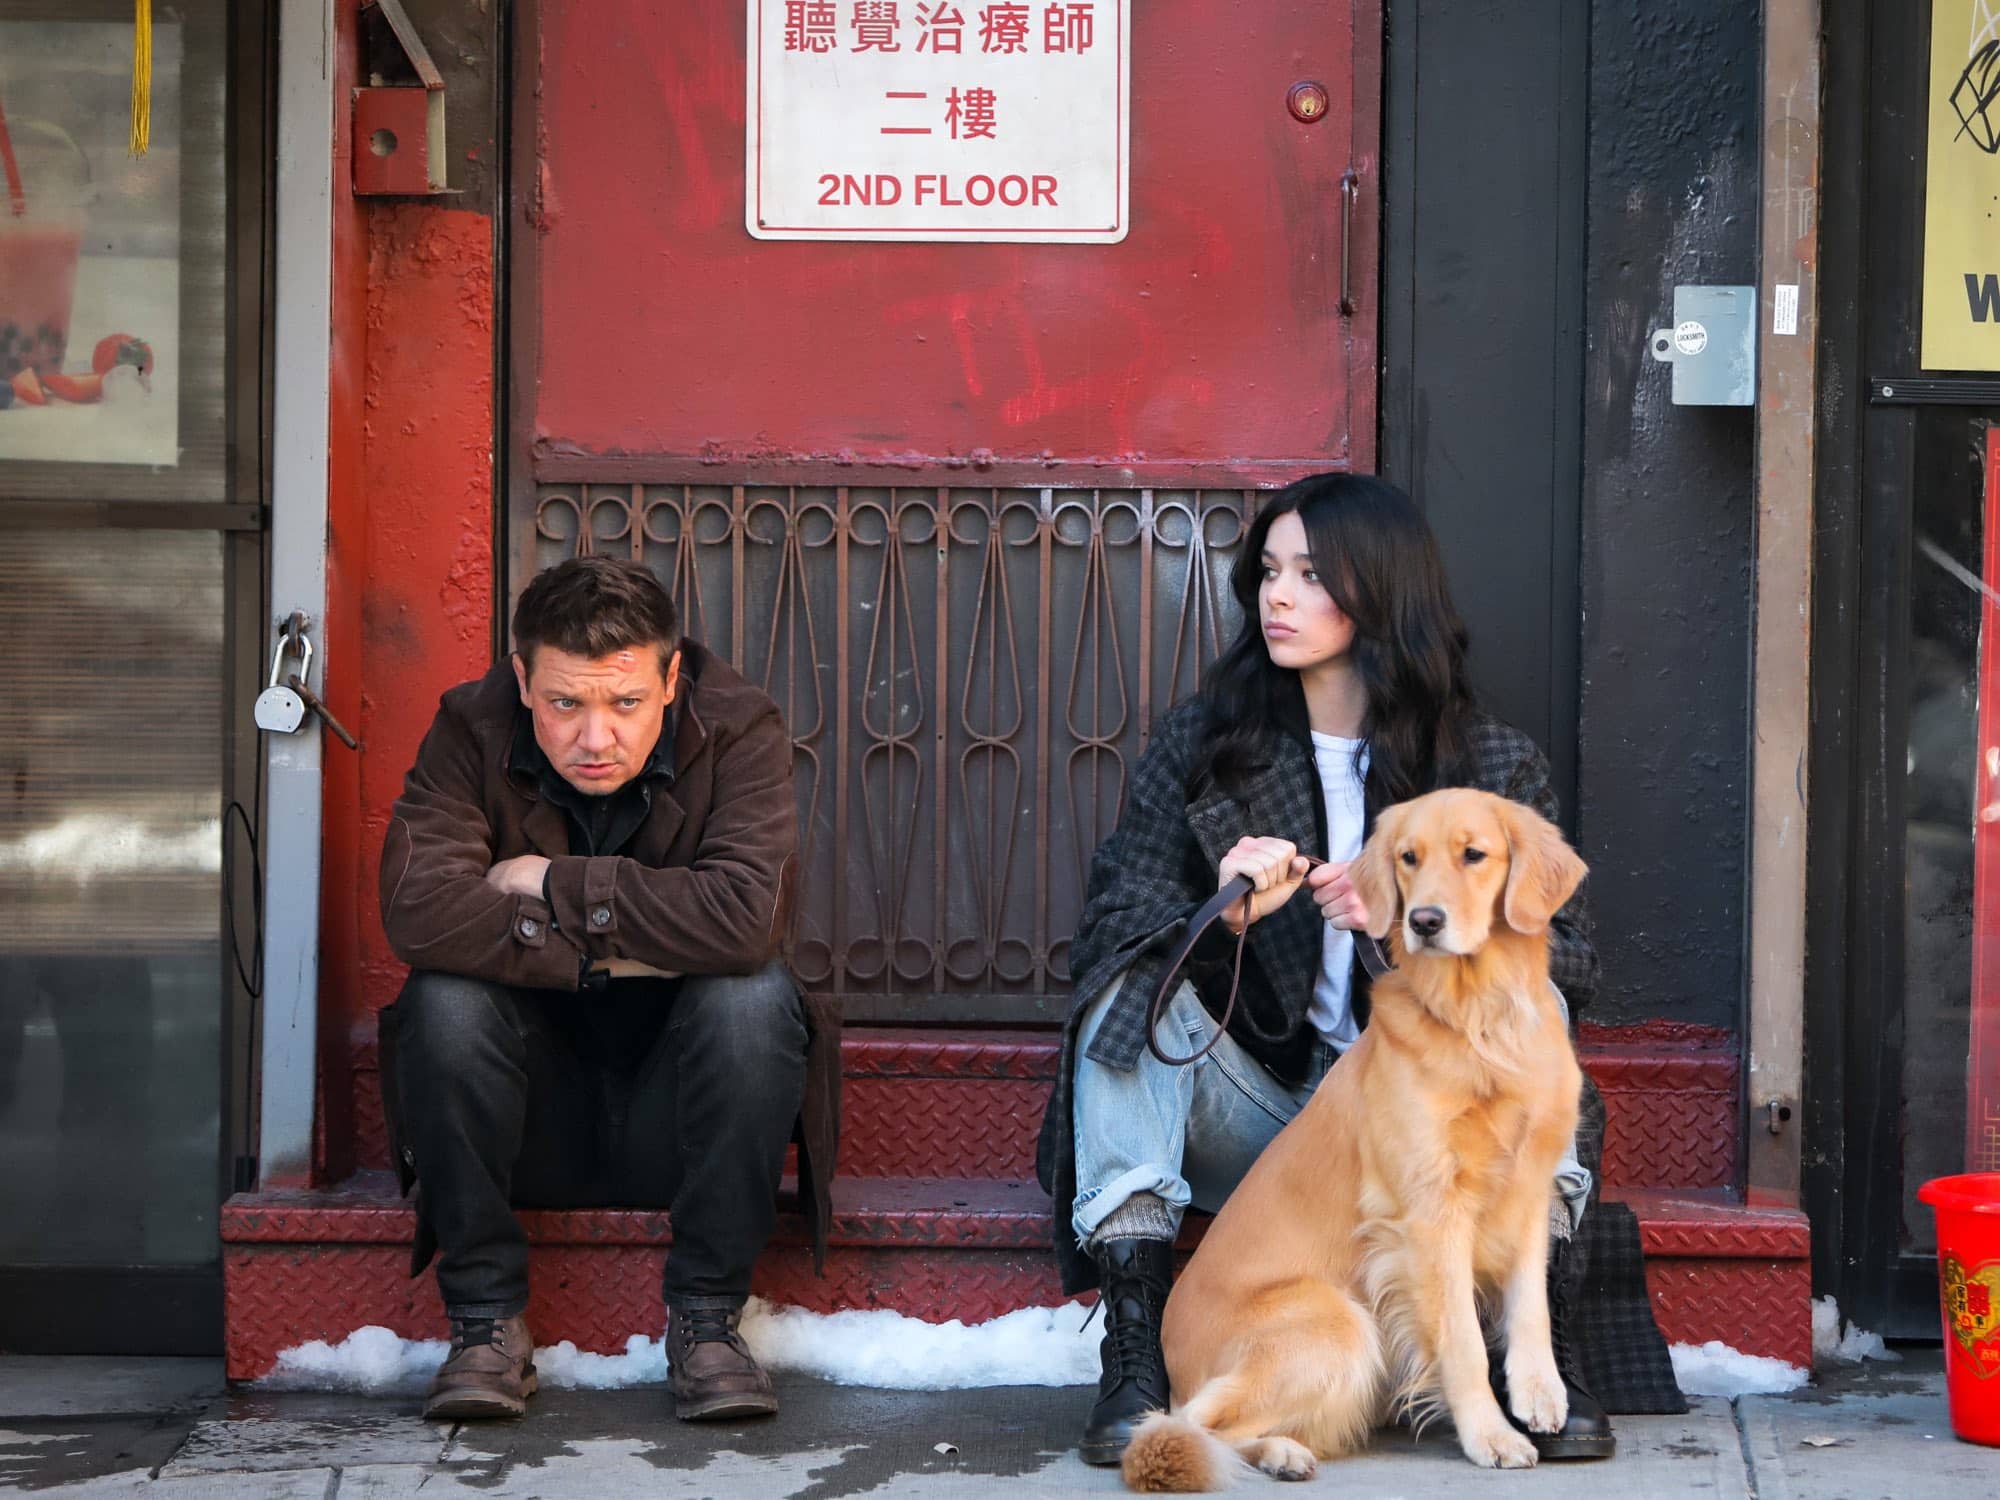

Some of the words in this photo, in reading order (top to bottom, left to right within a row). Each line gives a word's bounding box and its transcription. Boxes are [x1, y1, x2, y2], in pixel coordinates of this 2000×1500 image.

[784, 0, 1094, 54] 聽覺治療師
[880, 87, 997, 140] 二樓
[818, 174, 902, 206] 2ND
[914, 175, 1058, 207] FLOOR
[1677, 332, 1705, 342] LOCKSMITH
